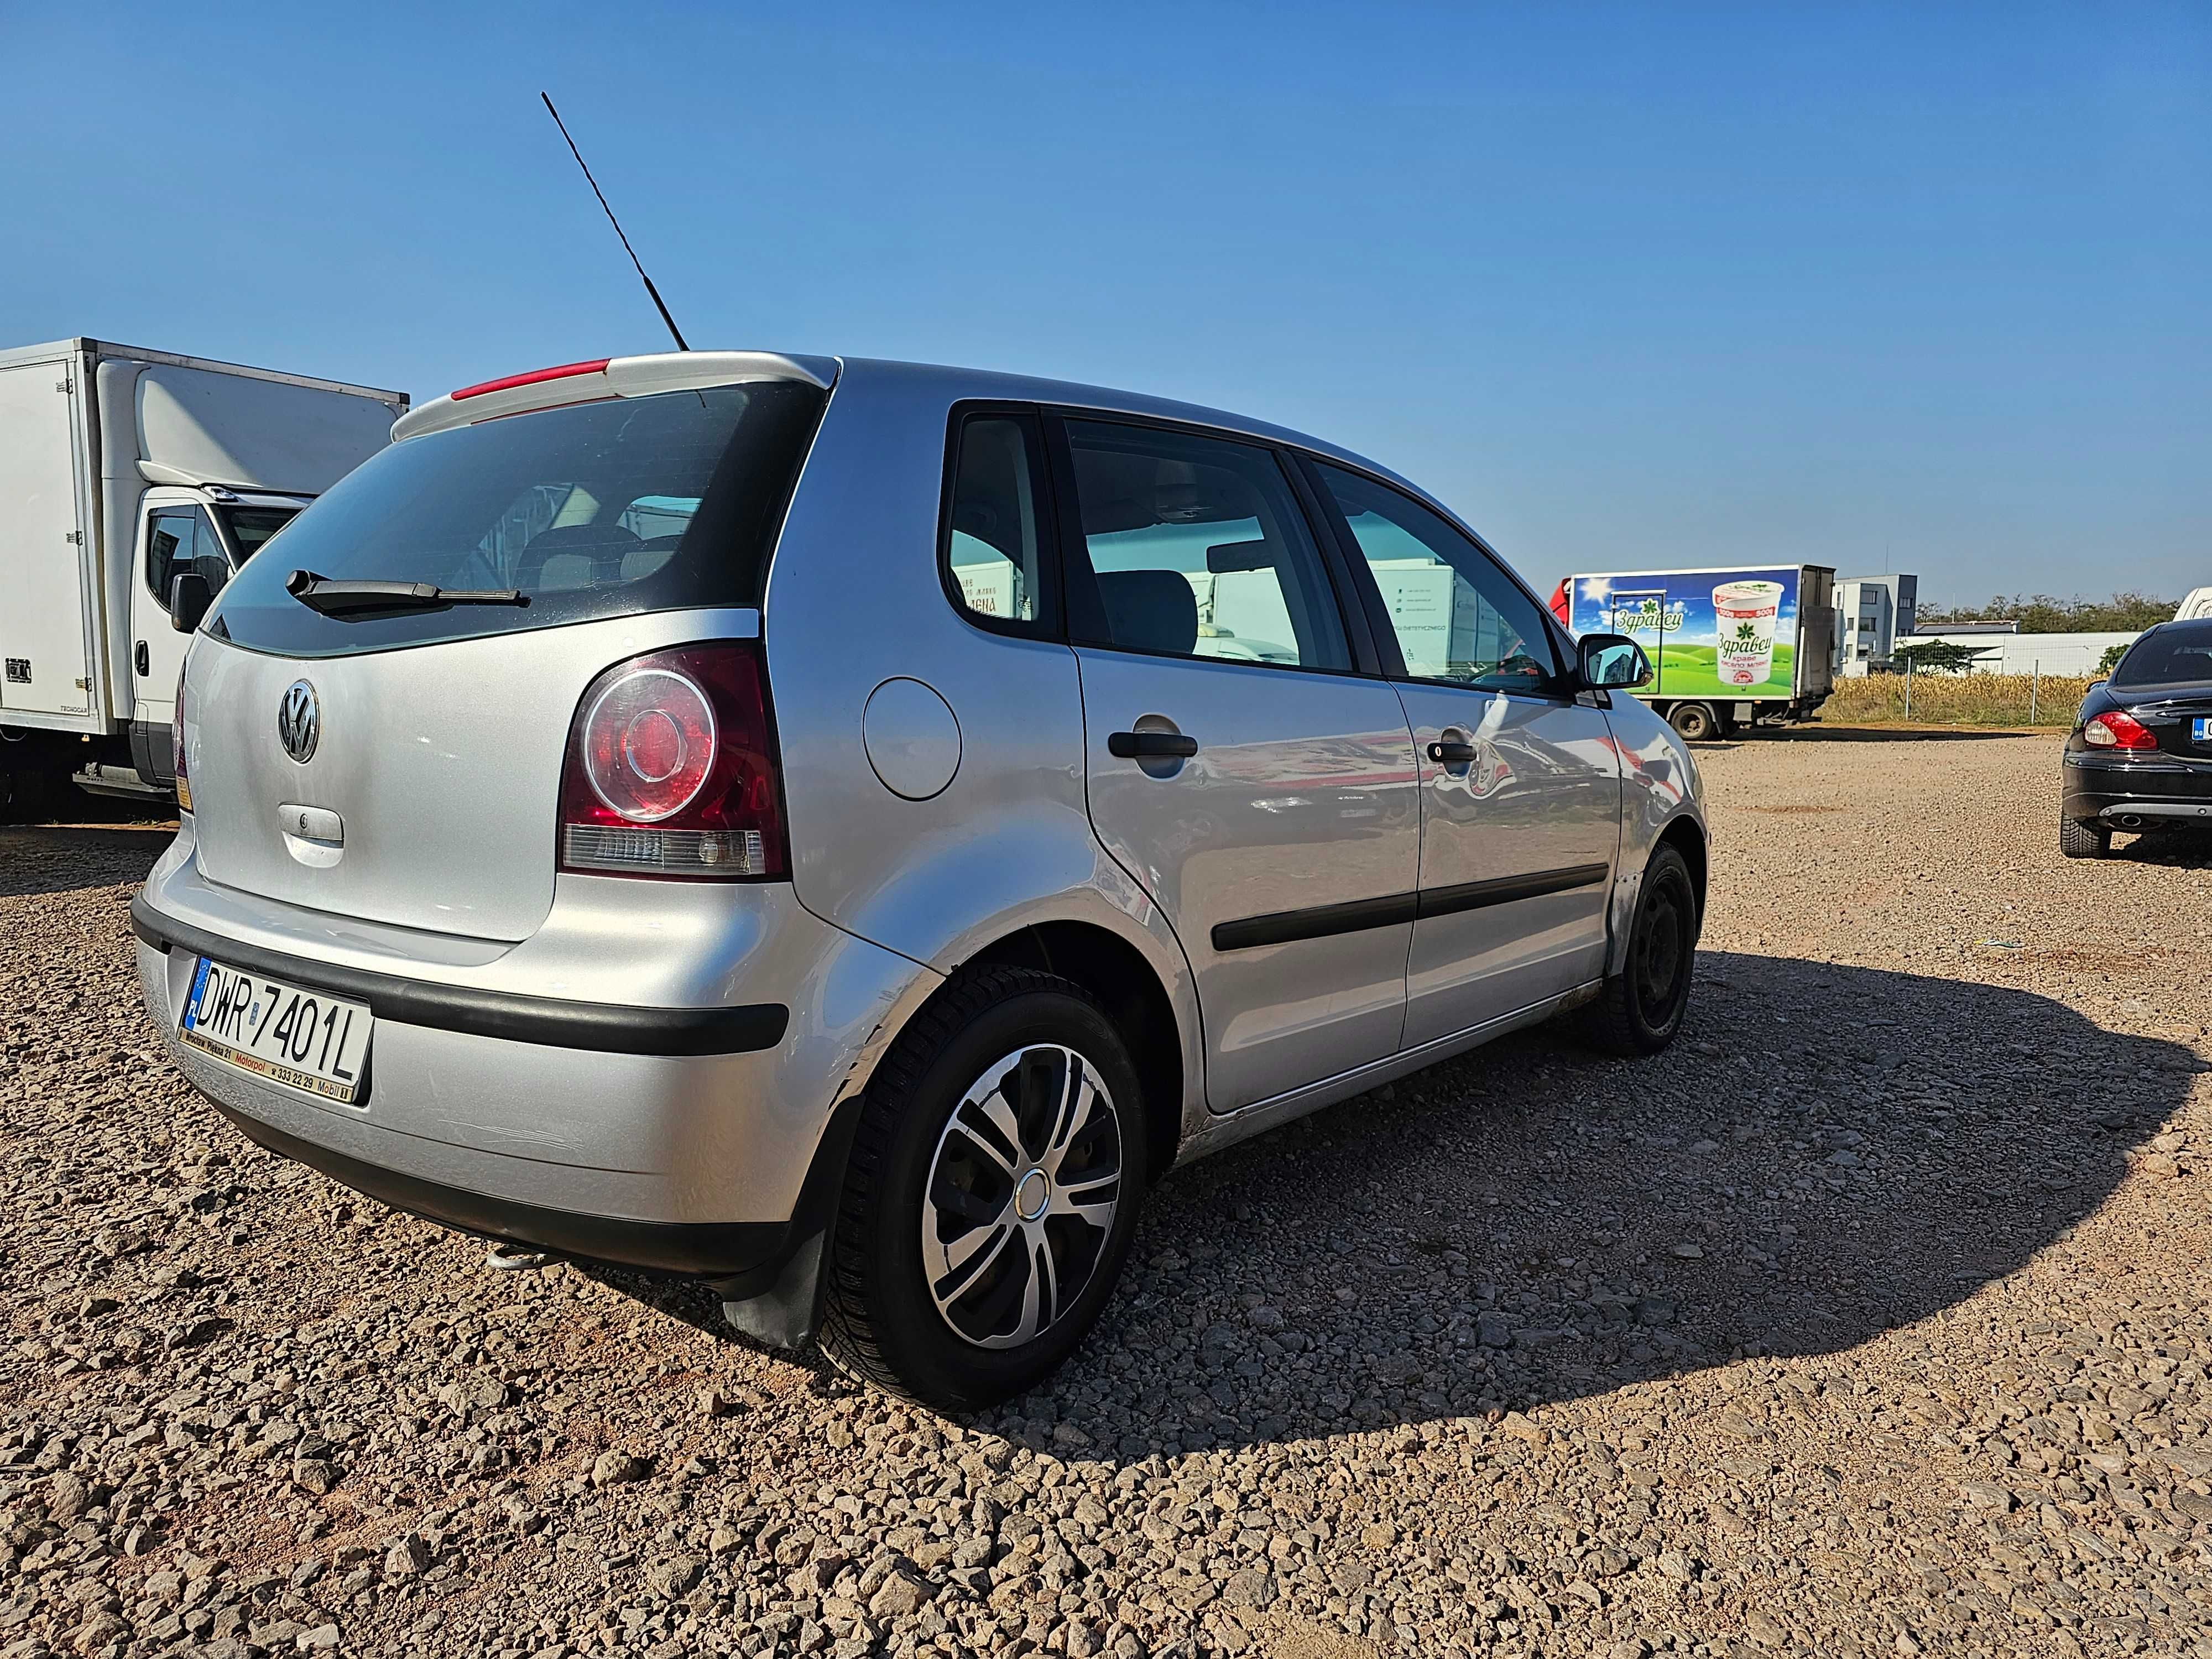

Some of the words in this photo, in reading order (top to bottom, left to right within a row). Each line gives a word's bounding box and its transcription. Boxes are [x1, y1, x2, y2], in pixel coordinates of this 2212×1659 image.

[188, 1000, 197, 1018] PL
[196, 967, 252, 1042] DWR
[250, 984, 354, 1081] 7401L
[224, 1048, 232, 1060] 21
[235, 1053, 266, 1072] Motorpol
[278, 1068, 291, 1082] 333
[292, 1073, 302, 1086] 22
[304, 1077, 314, 1089] 29
[317, 1081, 339, 1097] Mobil
